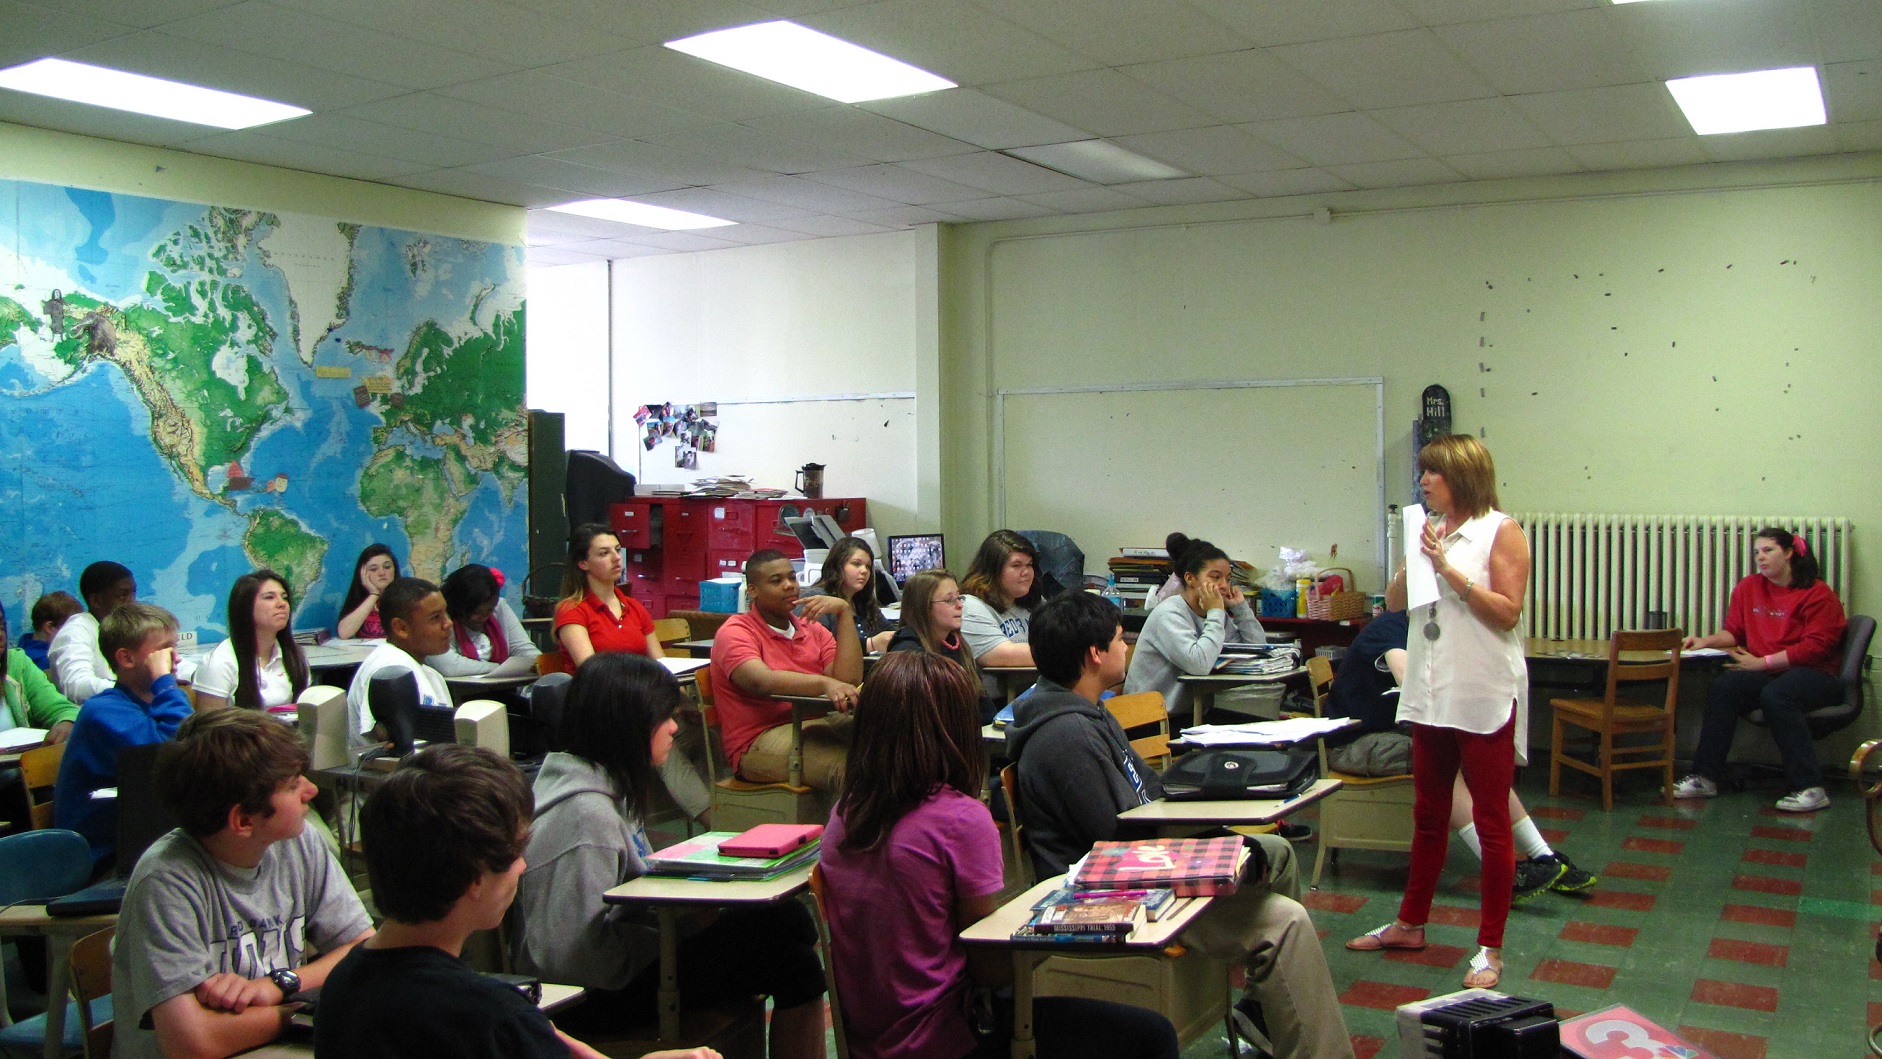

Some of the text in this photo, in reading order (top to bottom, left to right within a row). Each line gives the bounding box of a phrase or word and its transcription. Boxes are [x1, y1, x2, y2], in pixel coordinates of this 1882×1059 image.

[1426, 397, 1444, 405] Mrs.
[1426, 406, 1445, 417] Hill
[1053, 924, 1085, 932] MISSISSIPPI
